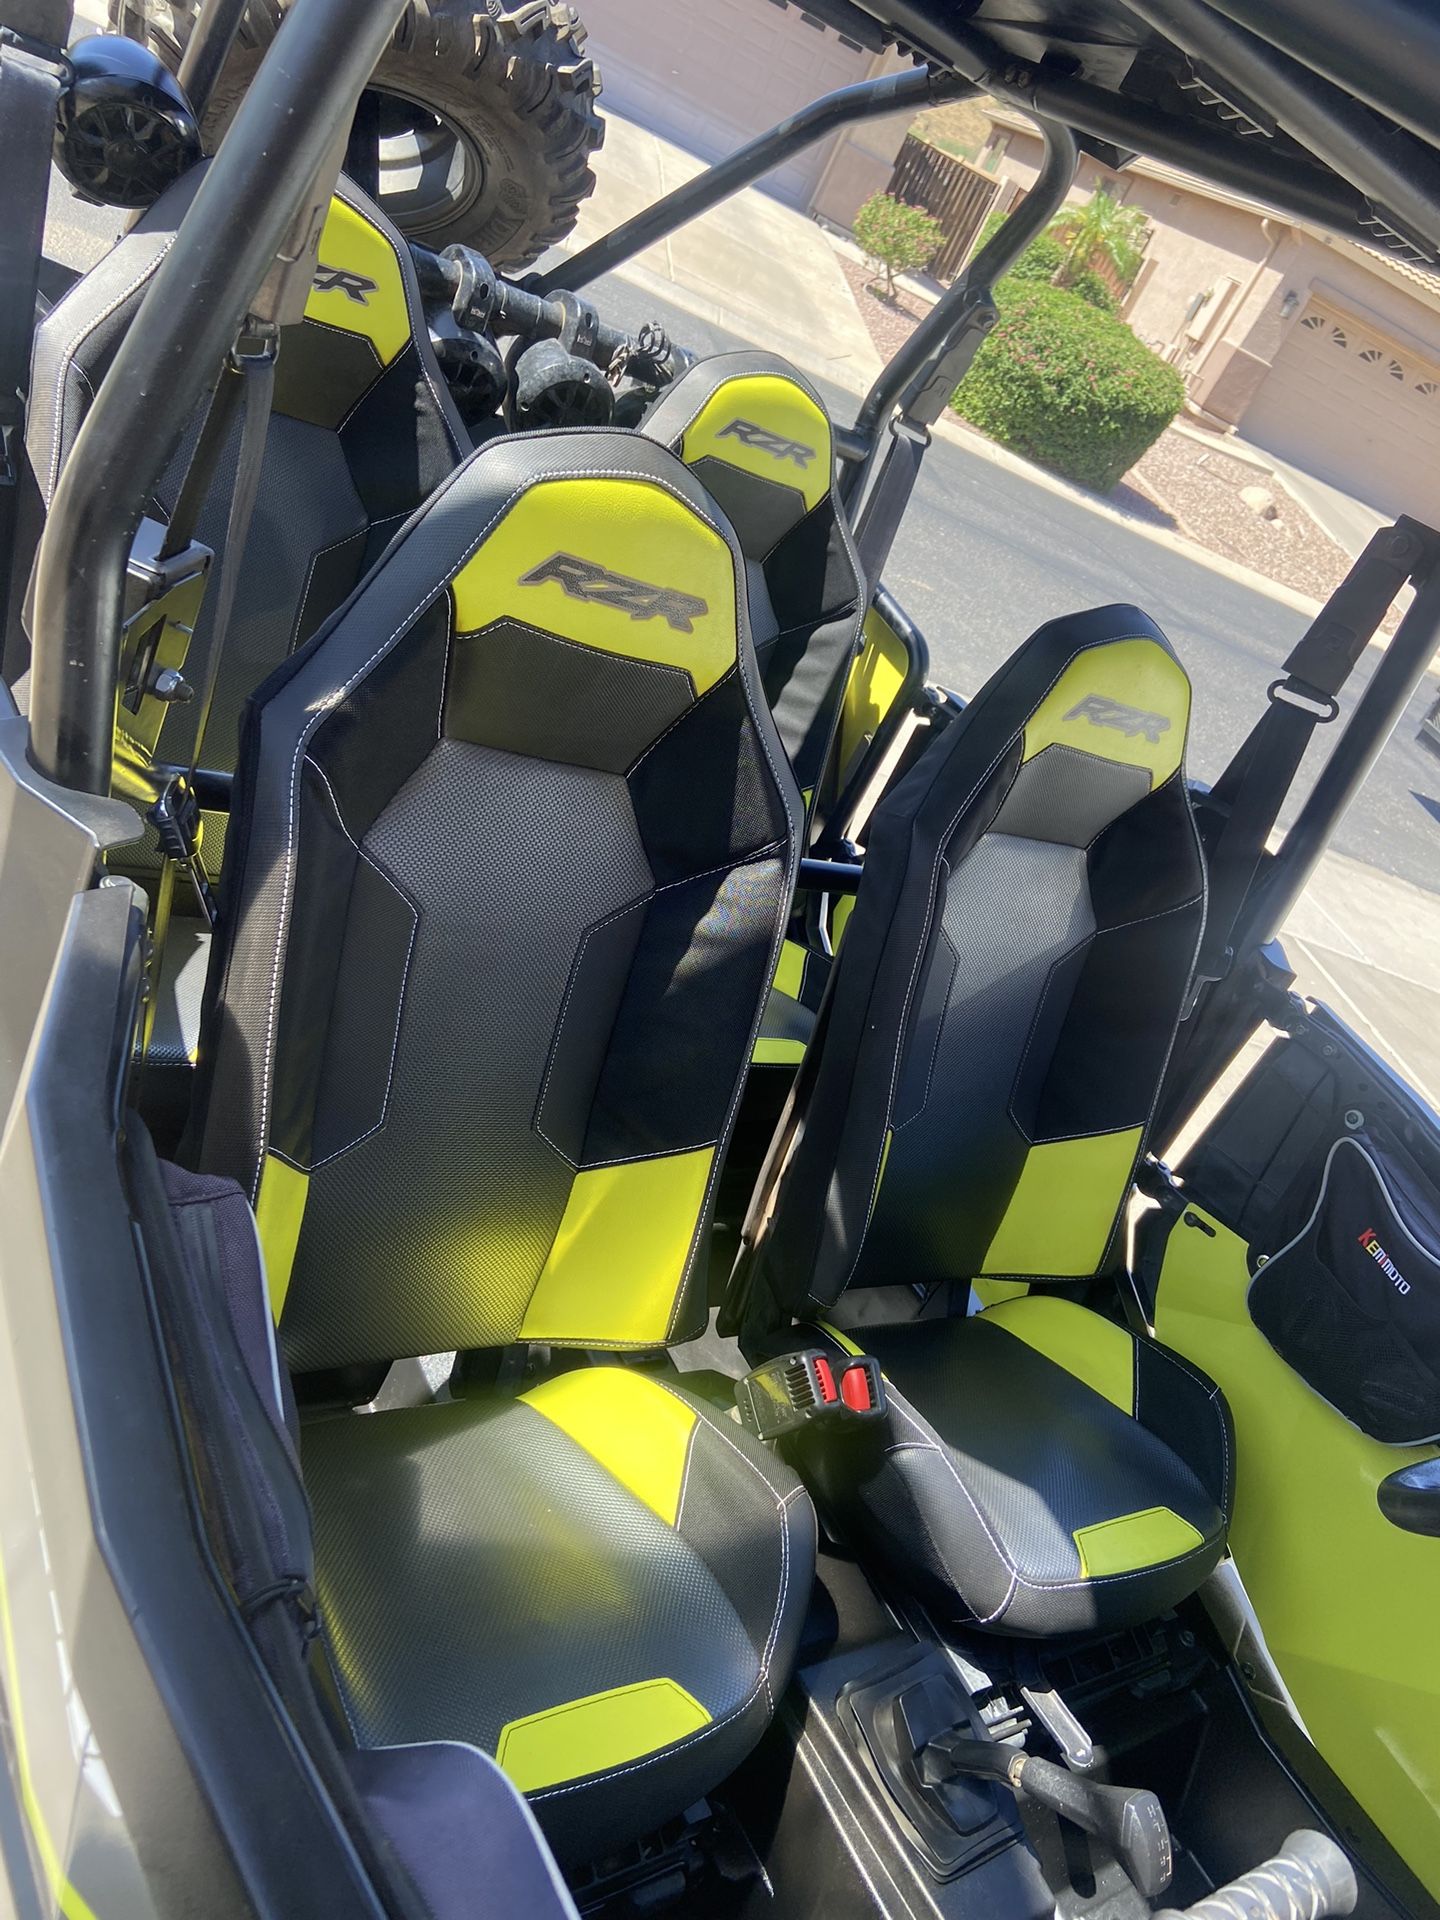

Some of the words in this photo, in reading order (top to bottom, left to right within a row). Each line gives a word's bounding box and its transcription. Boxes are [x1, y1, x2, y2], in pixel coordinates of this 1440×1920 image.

[715, 417, 818, 470] RZR
[517, 551, 709, 635] RZR
[1062, 693, 1171, 745] RZR
